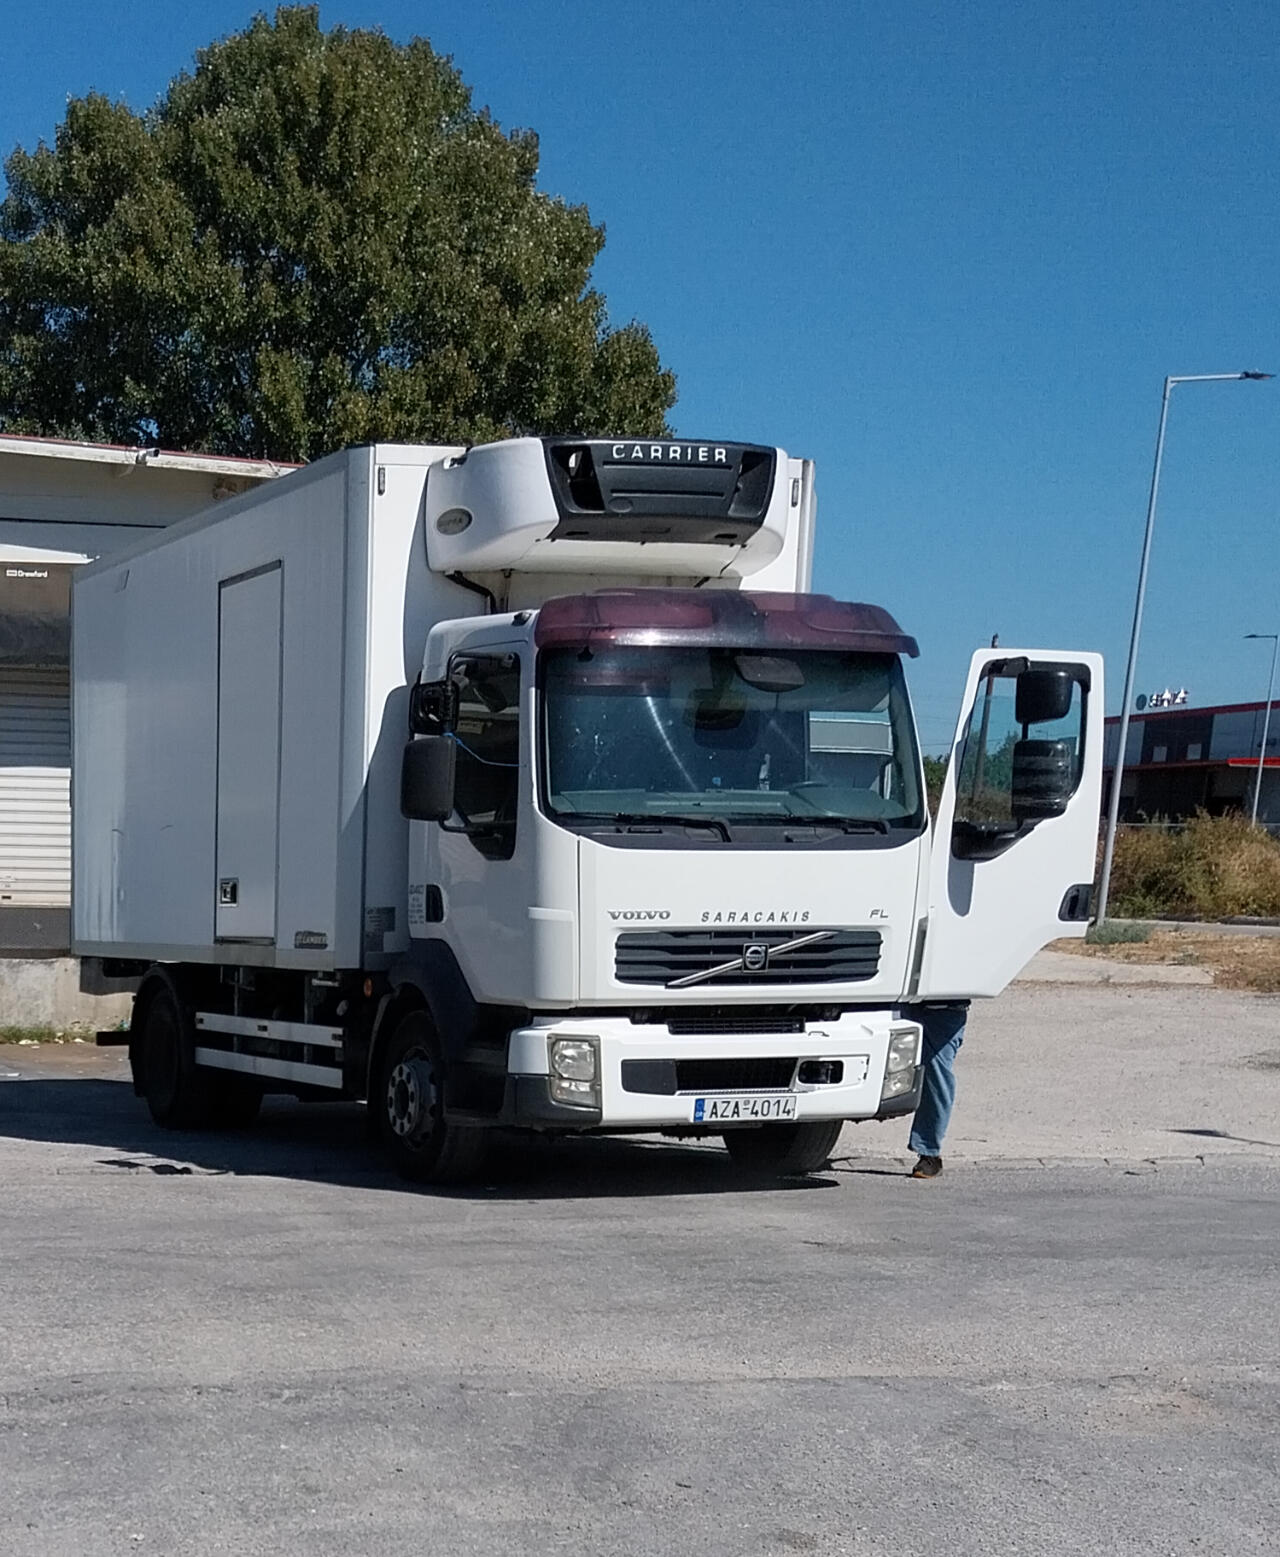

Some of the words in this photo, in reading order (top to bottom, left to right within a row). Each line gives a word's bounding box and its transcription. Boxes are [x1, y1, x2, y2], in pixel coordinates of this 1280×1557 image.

[612, 444, 727, 463] CARRIER
[607, 910, 671, 920] VOLVO
[701, 911, 810, 922] SARACAKIS
[869, 909, 889, 918] FL
